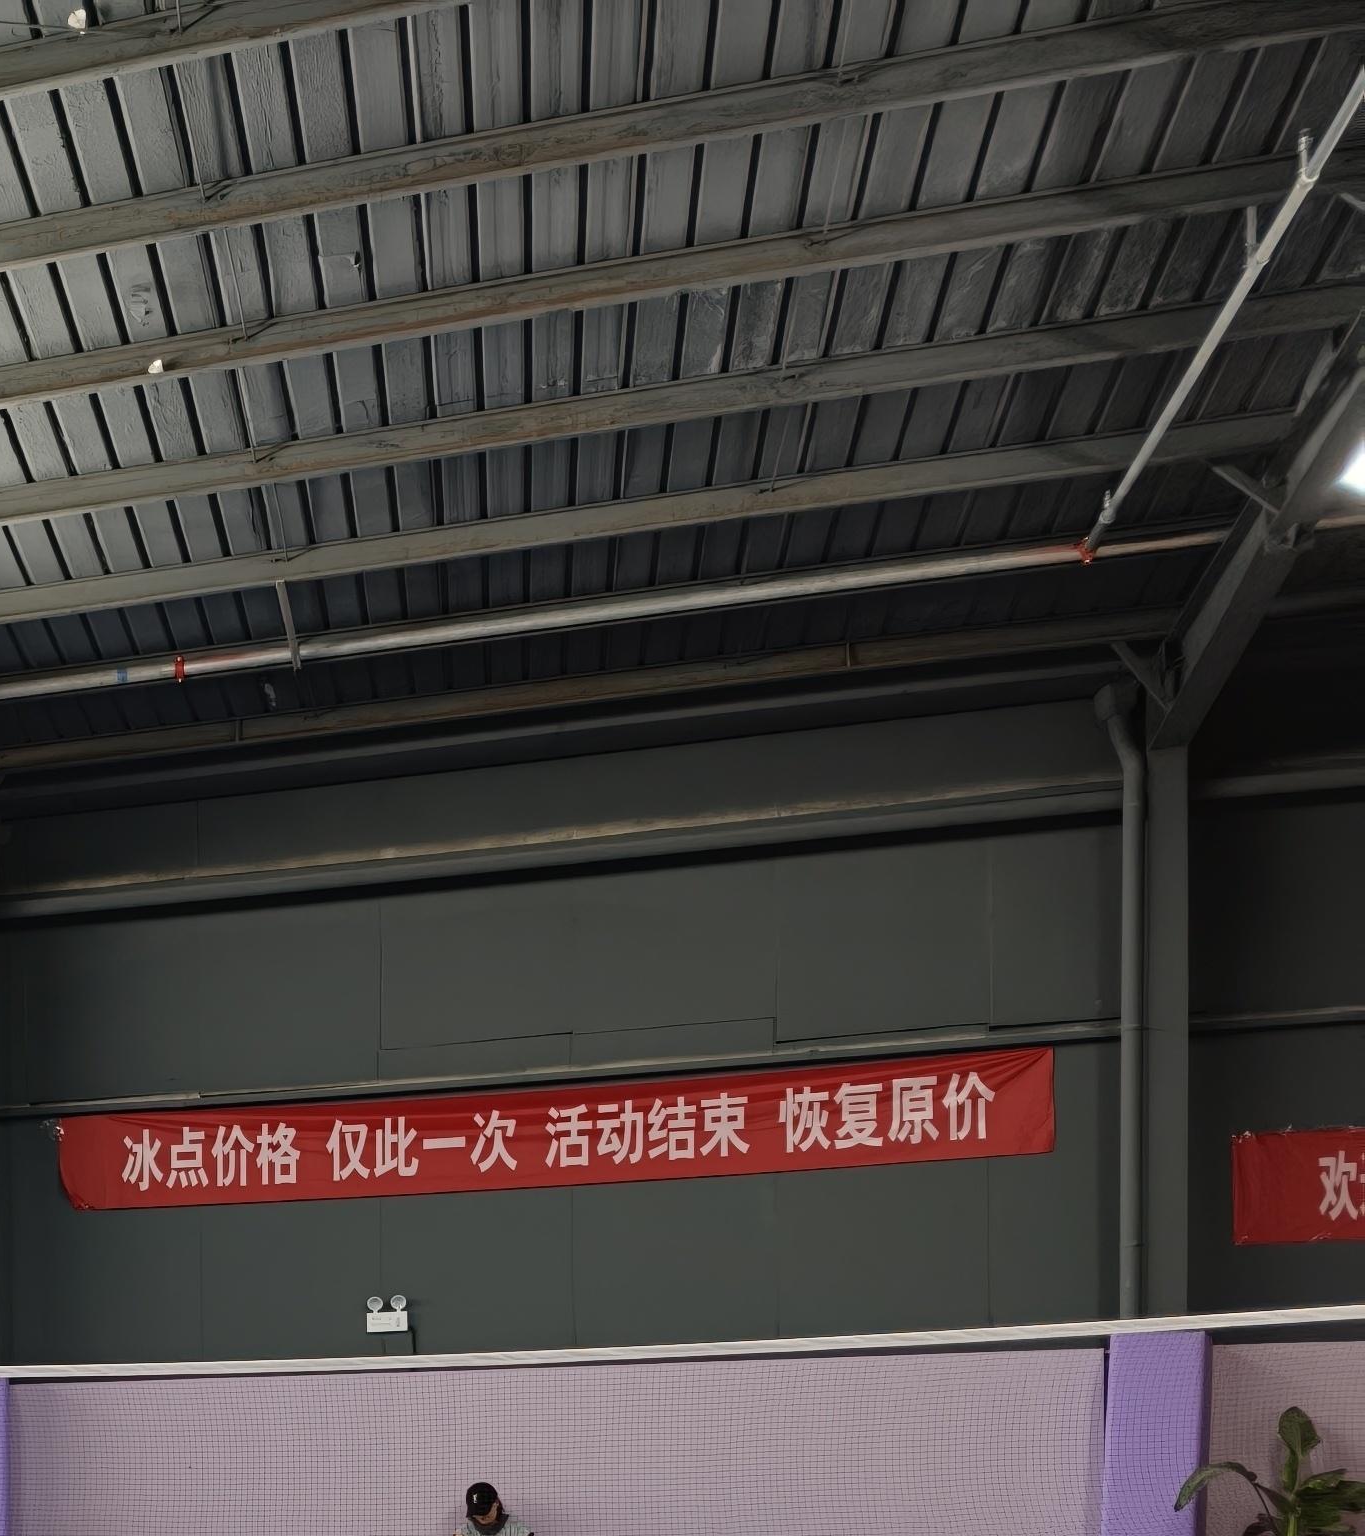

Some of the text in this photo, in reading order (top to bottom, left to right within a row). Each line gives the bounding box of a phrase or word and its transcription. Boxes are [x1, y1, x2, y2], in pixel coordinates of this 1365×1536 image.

[121, 1071, 996, 1191] 冰点价格 仅此一次 活动结束 恢复原价
[1318, 1150, 1365, 1221] 欢
